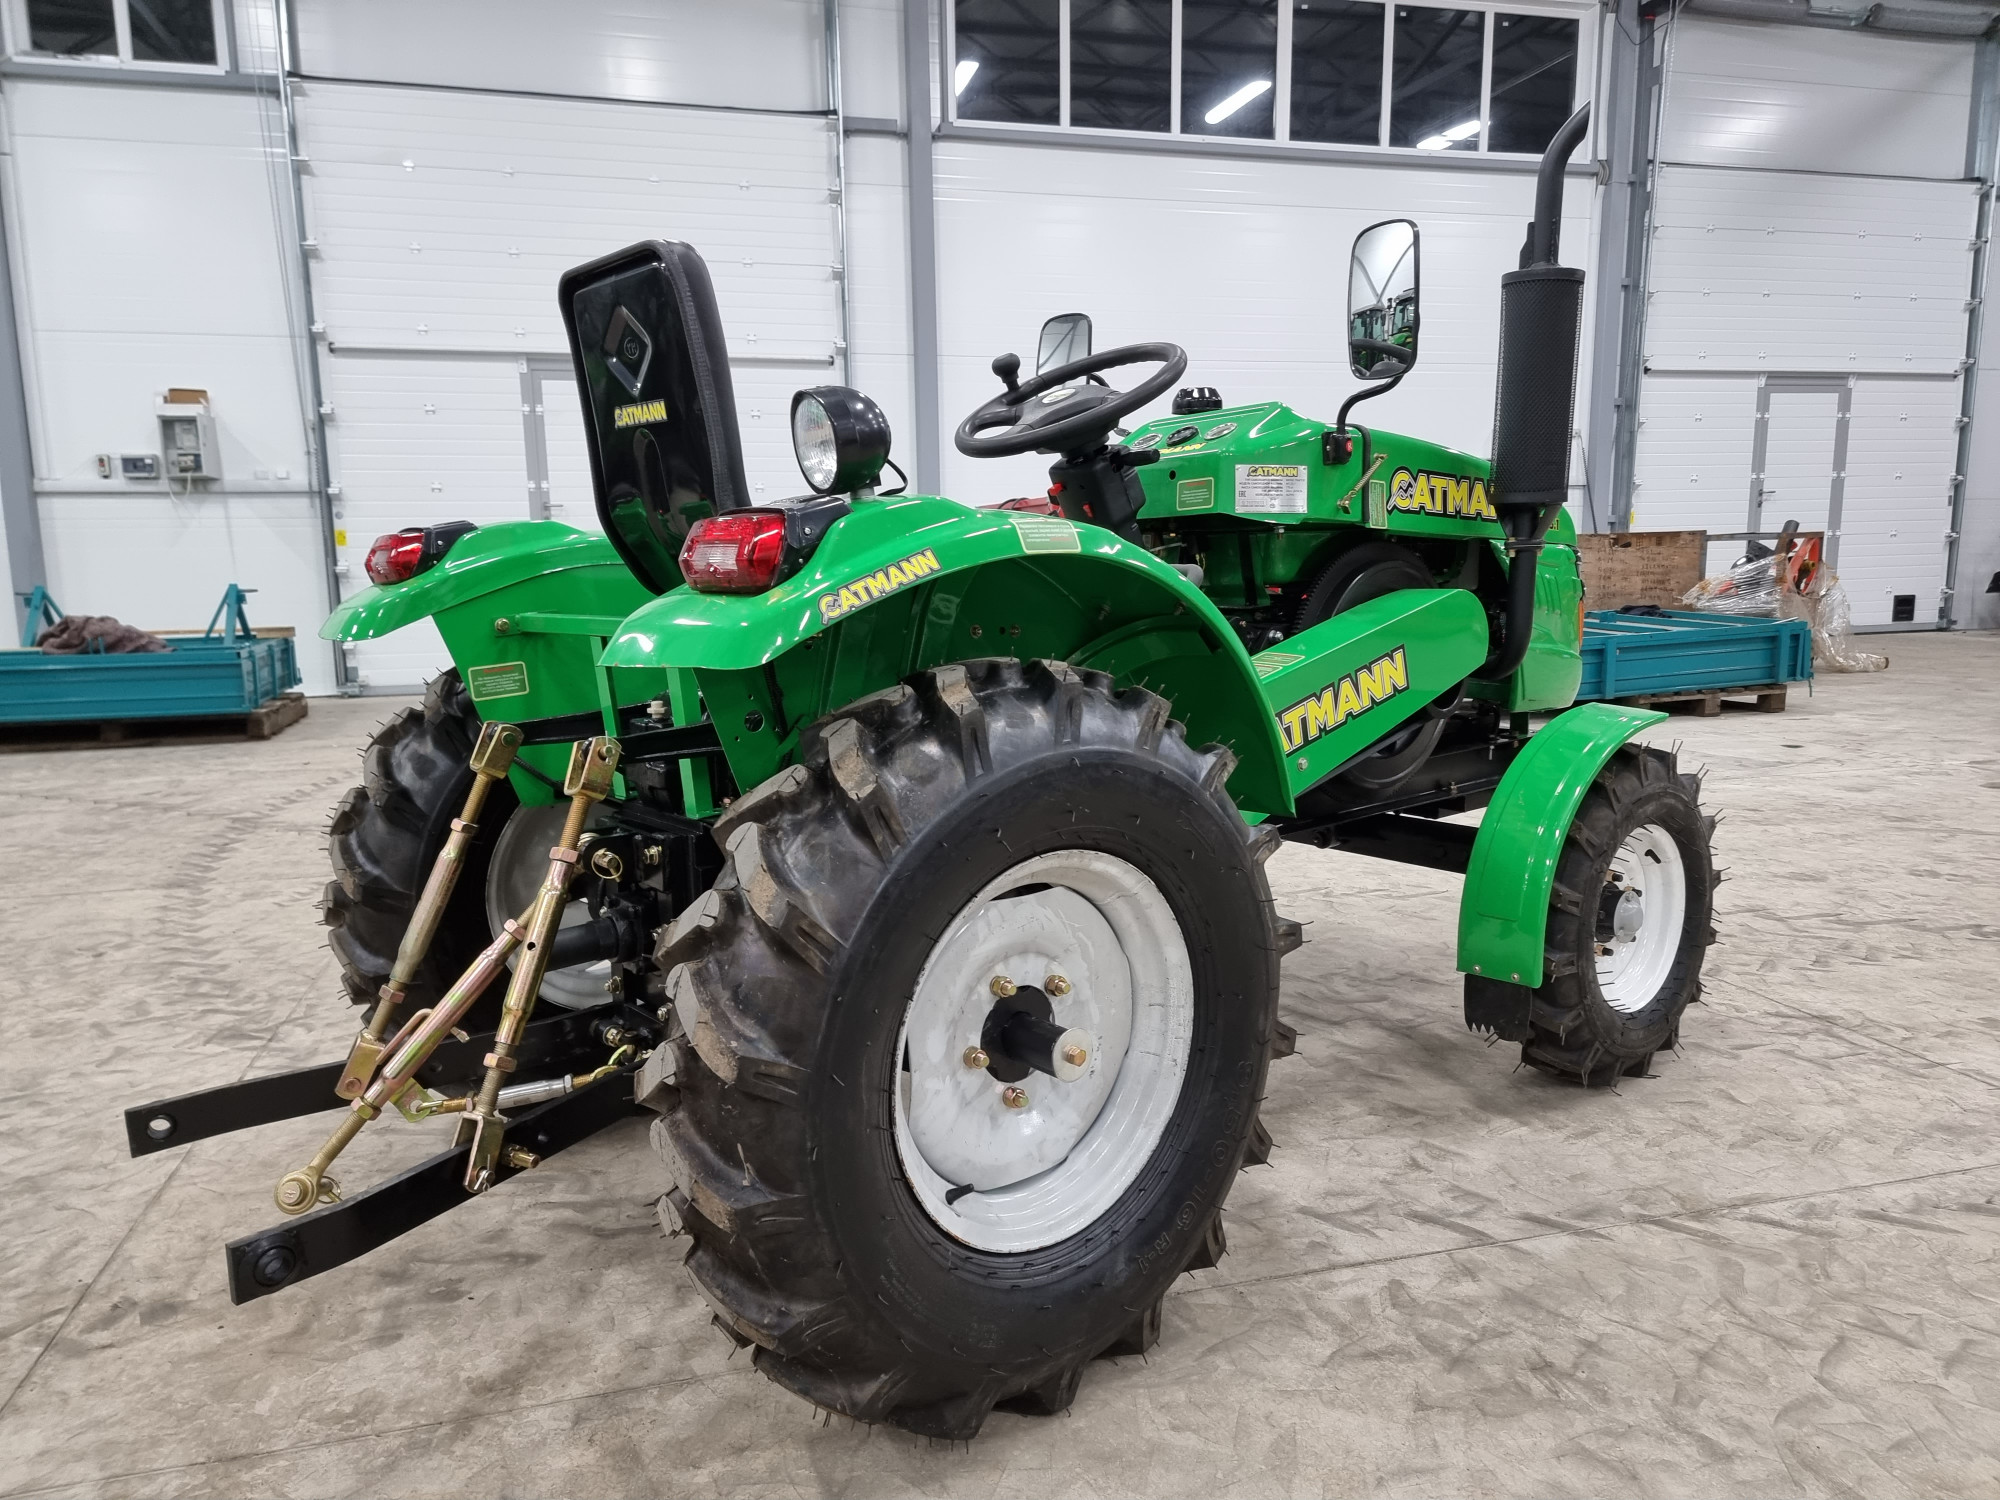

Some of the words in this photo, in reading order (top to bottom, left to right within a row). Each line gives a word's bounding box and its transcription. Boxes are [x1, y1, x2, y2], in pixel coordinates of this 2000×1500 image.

[615, 399, 668, 429] CATMANN
[1247, 466, 1299, 478] CATMANN
[1387, 467, 1499, 522] CATMA
[818, 547, 941, 626] CATMANN
